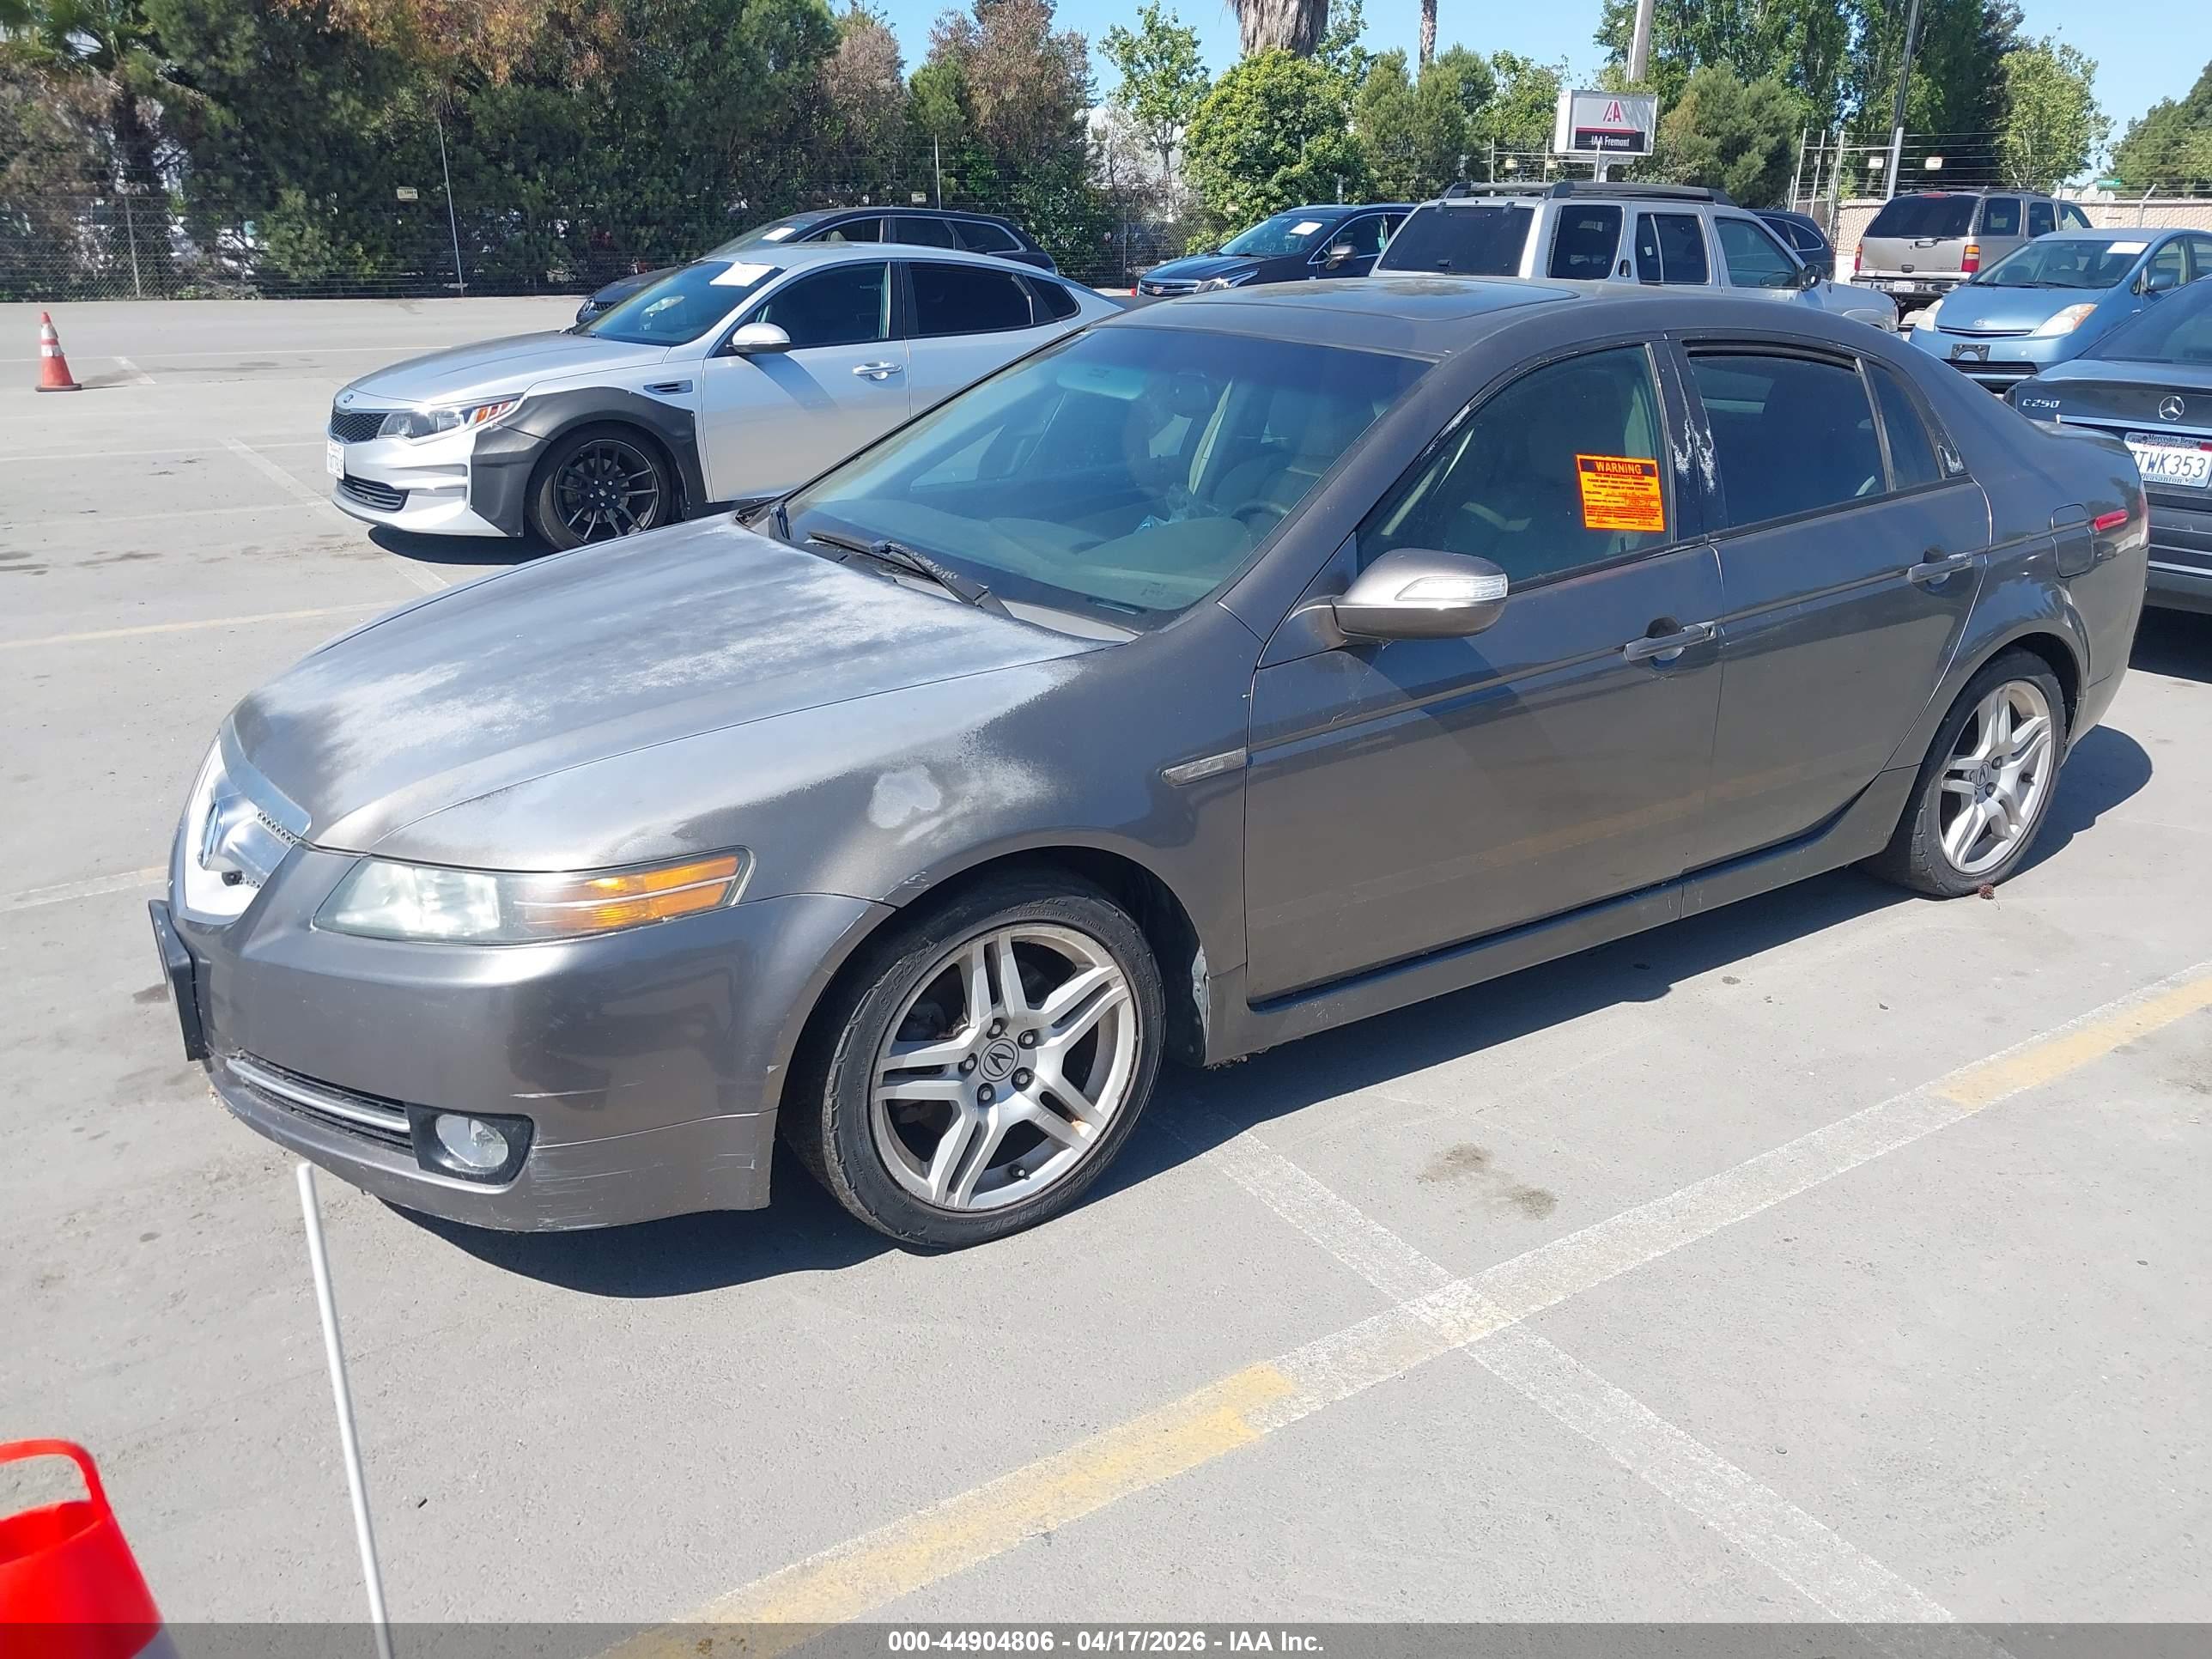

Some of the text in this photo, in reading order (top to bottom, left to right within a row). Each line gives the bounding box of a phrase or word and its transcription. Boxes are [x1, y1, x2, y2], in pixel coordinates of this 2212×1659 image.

[1591, 136, 1630, 147] IAA Fremont
[2022, 398, 2060, 409] C250
[1595, 461, 1643, 474] WARNING
